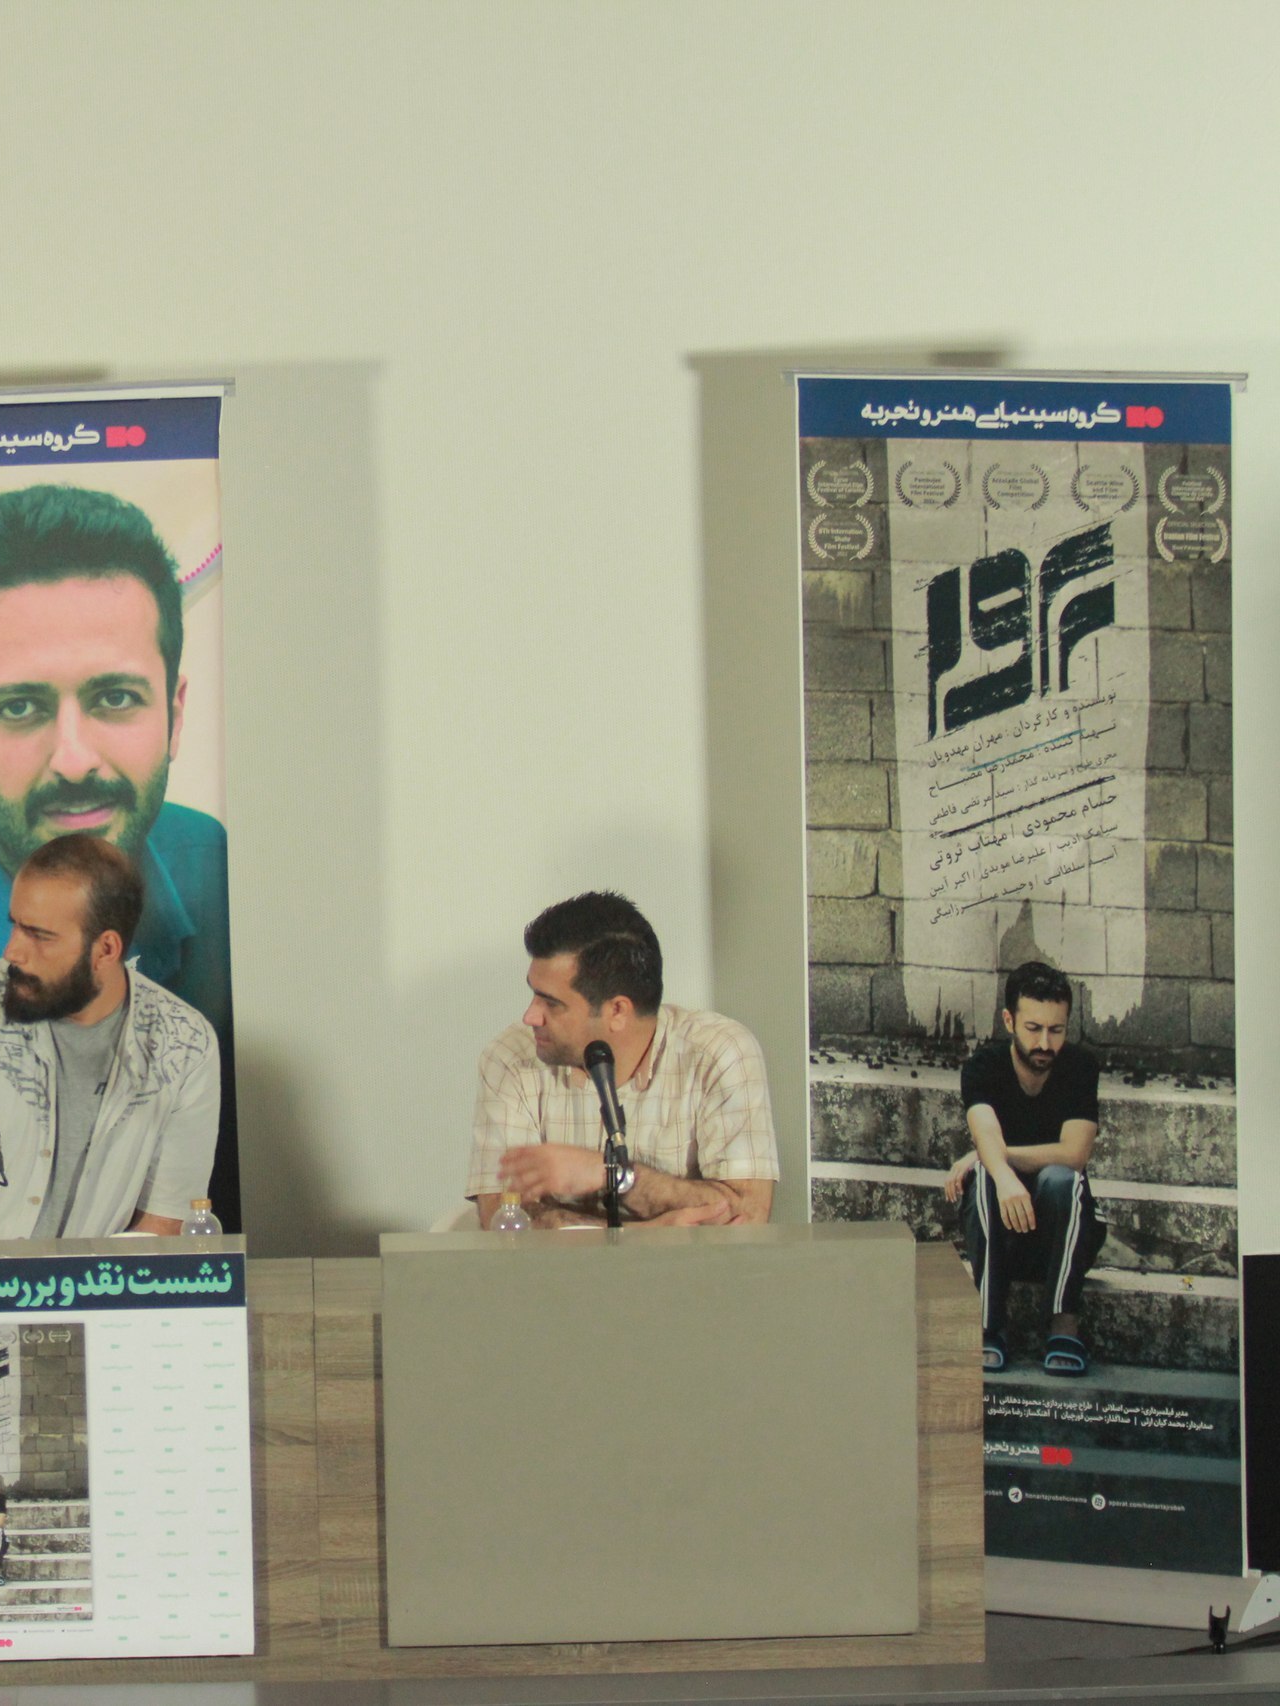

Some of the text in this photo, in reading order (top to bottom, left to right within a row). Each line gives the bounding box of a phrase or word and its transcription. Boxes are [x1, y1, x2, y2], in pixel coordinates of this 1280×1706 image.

[976, 400, 1068, 429] سینمایی
[1069, 401, 1122, 429] گروه
[43, 423, 100, 452] گروه
[928, 688, 1116, 768] نویسنده و کارگردان مهران مهدویان
[1080, 718, 1117, 741] تهیه
[1044, 735, 1074, 753] کننده
[928, 770, 983, 798] مصباح
[994, 786, 1015, 800] سید
[929, 803, 957, 826] فاطمی
[930, 794, 1118, 872] حسام محمودی مهتاب ثروتی
[1057, 832, 1080, 852] ادیب
[1082, 824, 1118, 841] سیامک
[1012, 848, 1046, 865] علیرضا
[954, 871, 971, 890] اکبر
[1044, 862, 1085, 886] سلطانی
[1002, 880, 1034, 896] وحید
[78, 1262, 126, 1296] نقد
[128, 1261, 232, 1295] نشست
[58, 1276, 76, 1307] و
